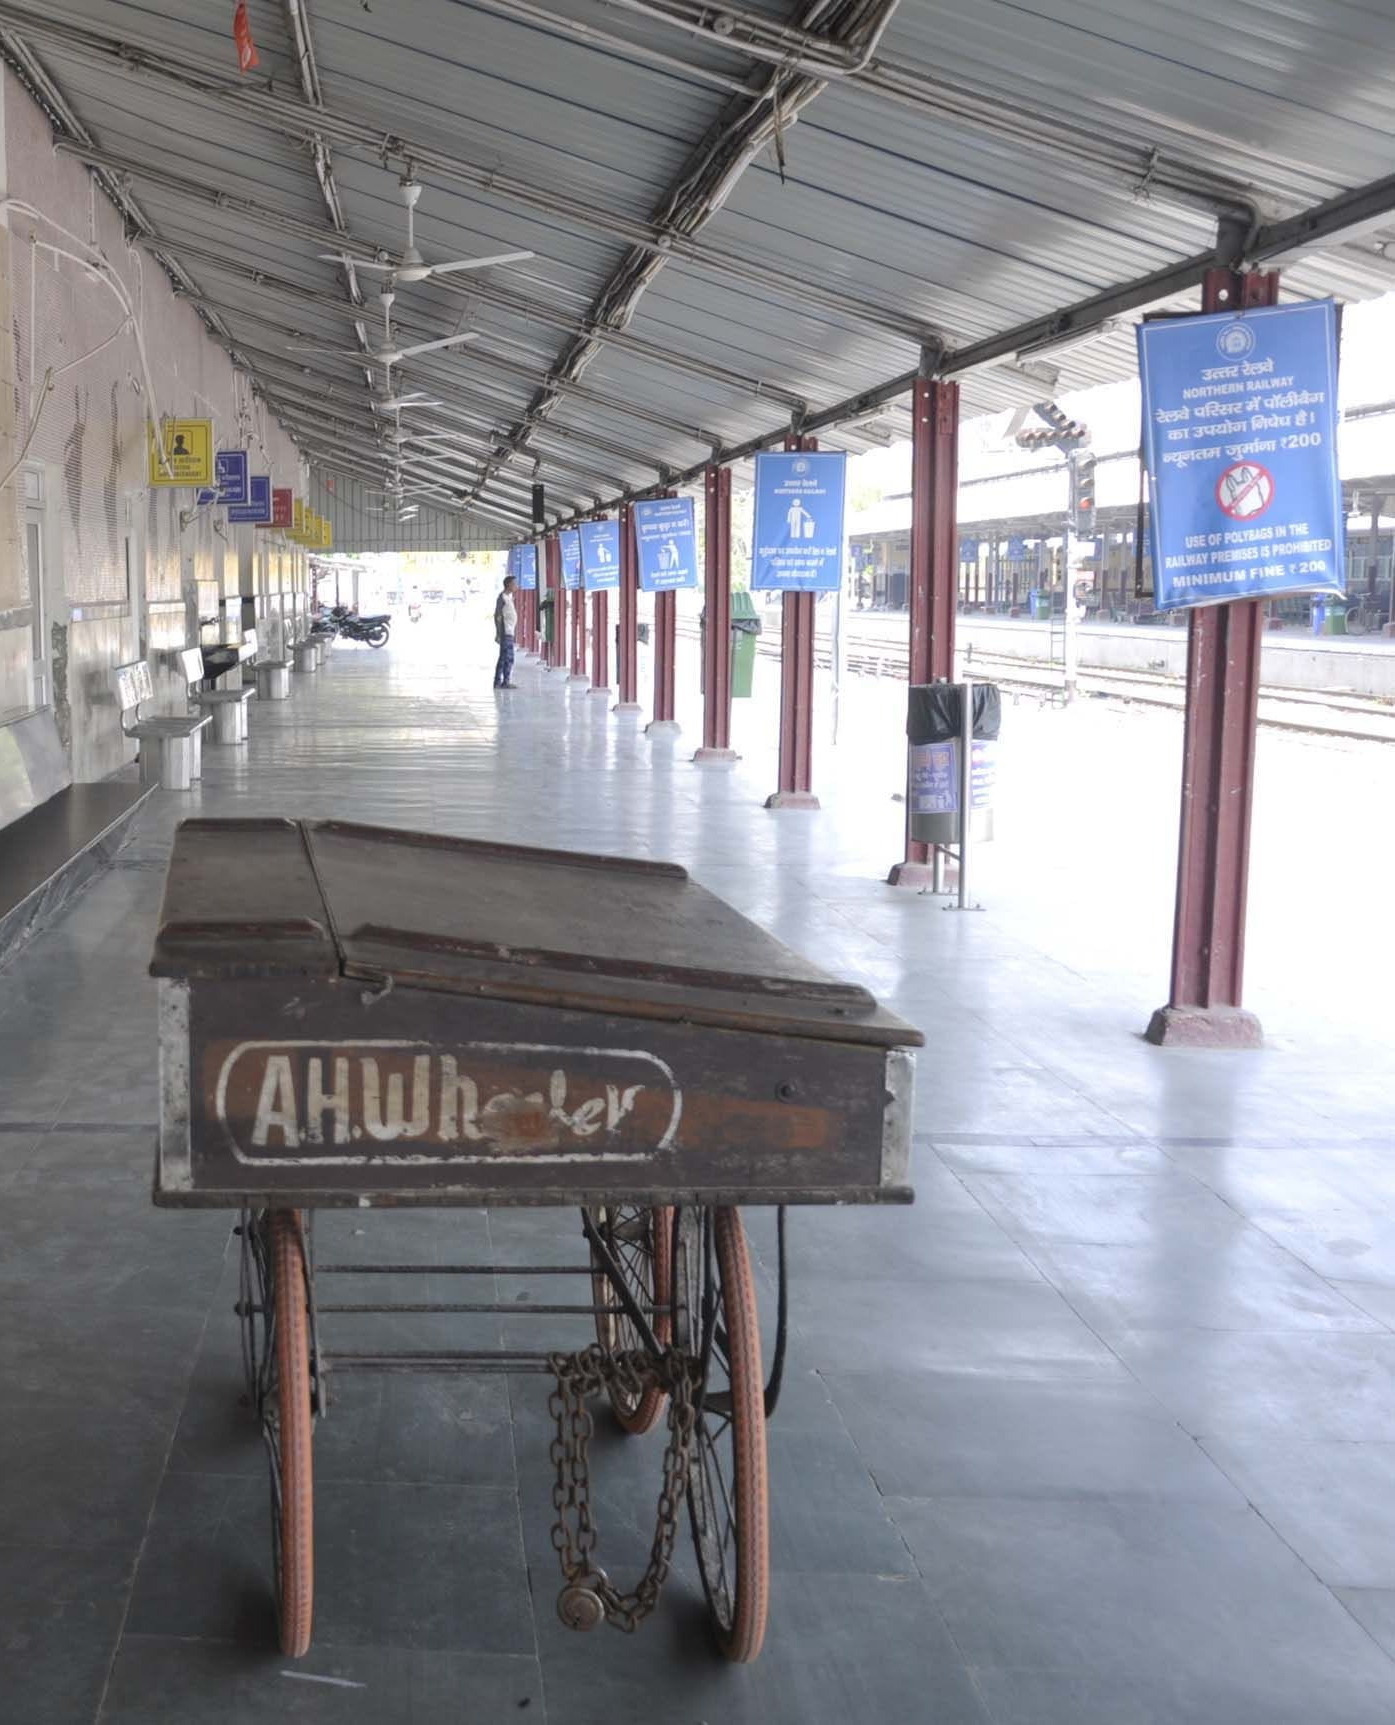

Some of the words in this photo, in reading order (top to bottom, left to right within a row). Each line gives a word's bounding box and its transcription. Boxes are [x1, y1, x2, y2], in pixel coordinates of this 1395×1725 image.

[1201, 365, 1239, 380] उत्तर
[1242, 357, 1274, 376] रेलवे
[1183, 383, 1245, 399] NORTHERN
[1246, 376, 1294, 391] RAILWAY
[1156, 406, 1190, 423] रेलवे
[1194, 401, 1243, 418] परिसर
[1245, 396, 1261, 411] में
[1167, 428, 1189, 441] का
[1193, 419, 1248, 438] उपयोग
[1162, 447, 1221, 468] न्यूनतम
[1185, 534, 1206, 549] USE
[1208, 532, 1222, 546] OF
[1224, 527, 1273, 544] POLYBAGS
[1275, 525, 1287, 537] IN
[1289, 522, 1310, 536] THE
[1164, 553, 1208, 569] RAILWAY
[1211, 547, 1258, 564] PREMISES
[1260, 545, 1270, 559] IS
[1272, 538, 1332, 555] PROHIBITED
[1172, 570, 1246, 588] MINIMUM
[1250, 564, 1286, 580] FINE
